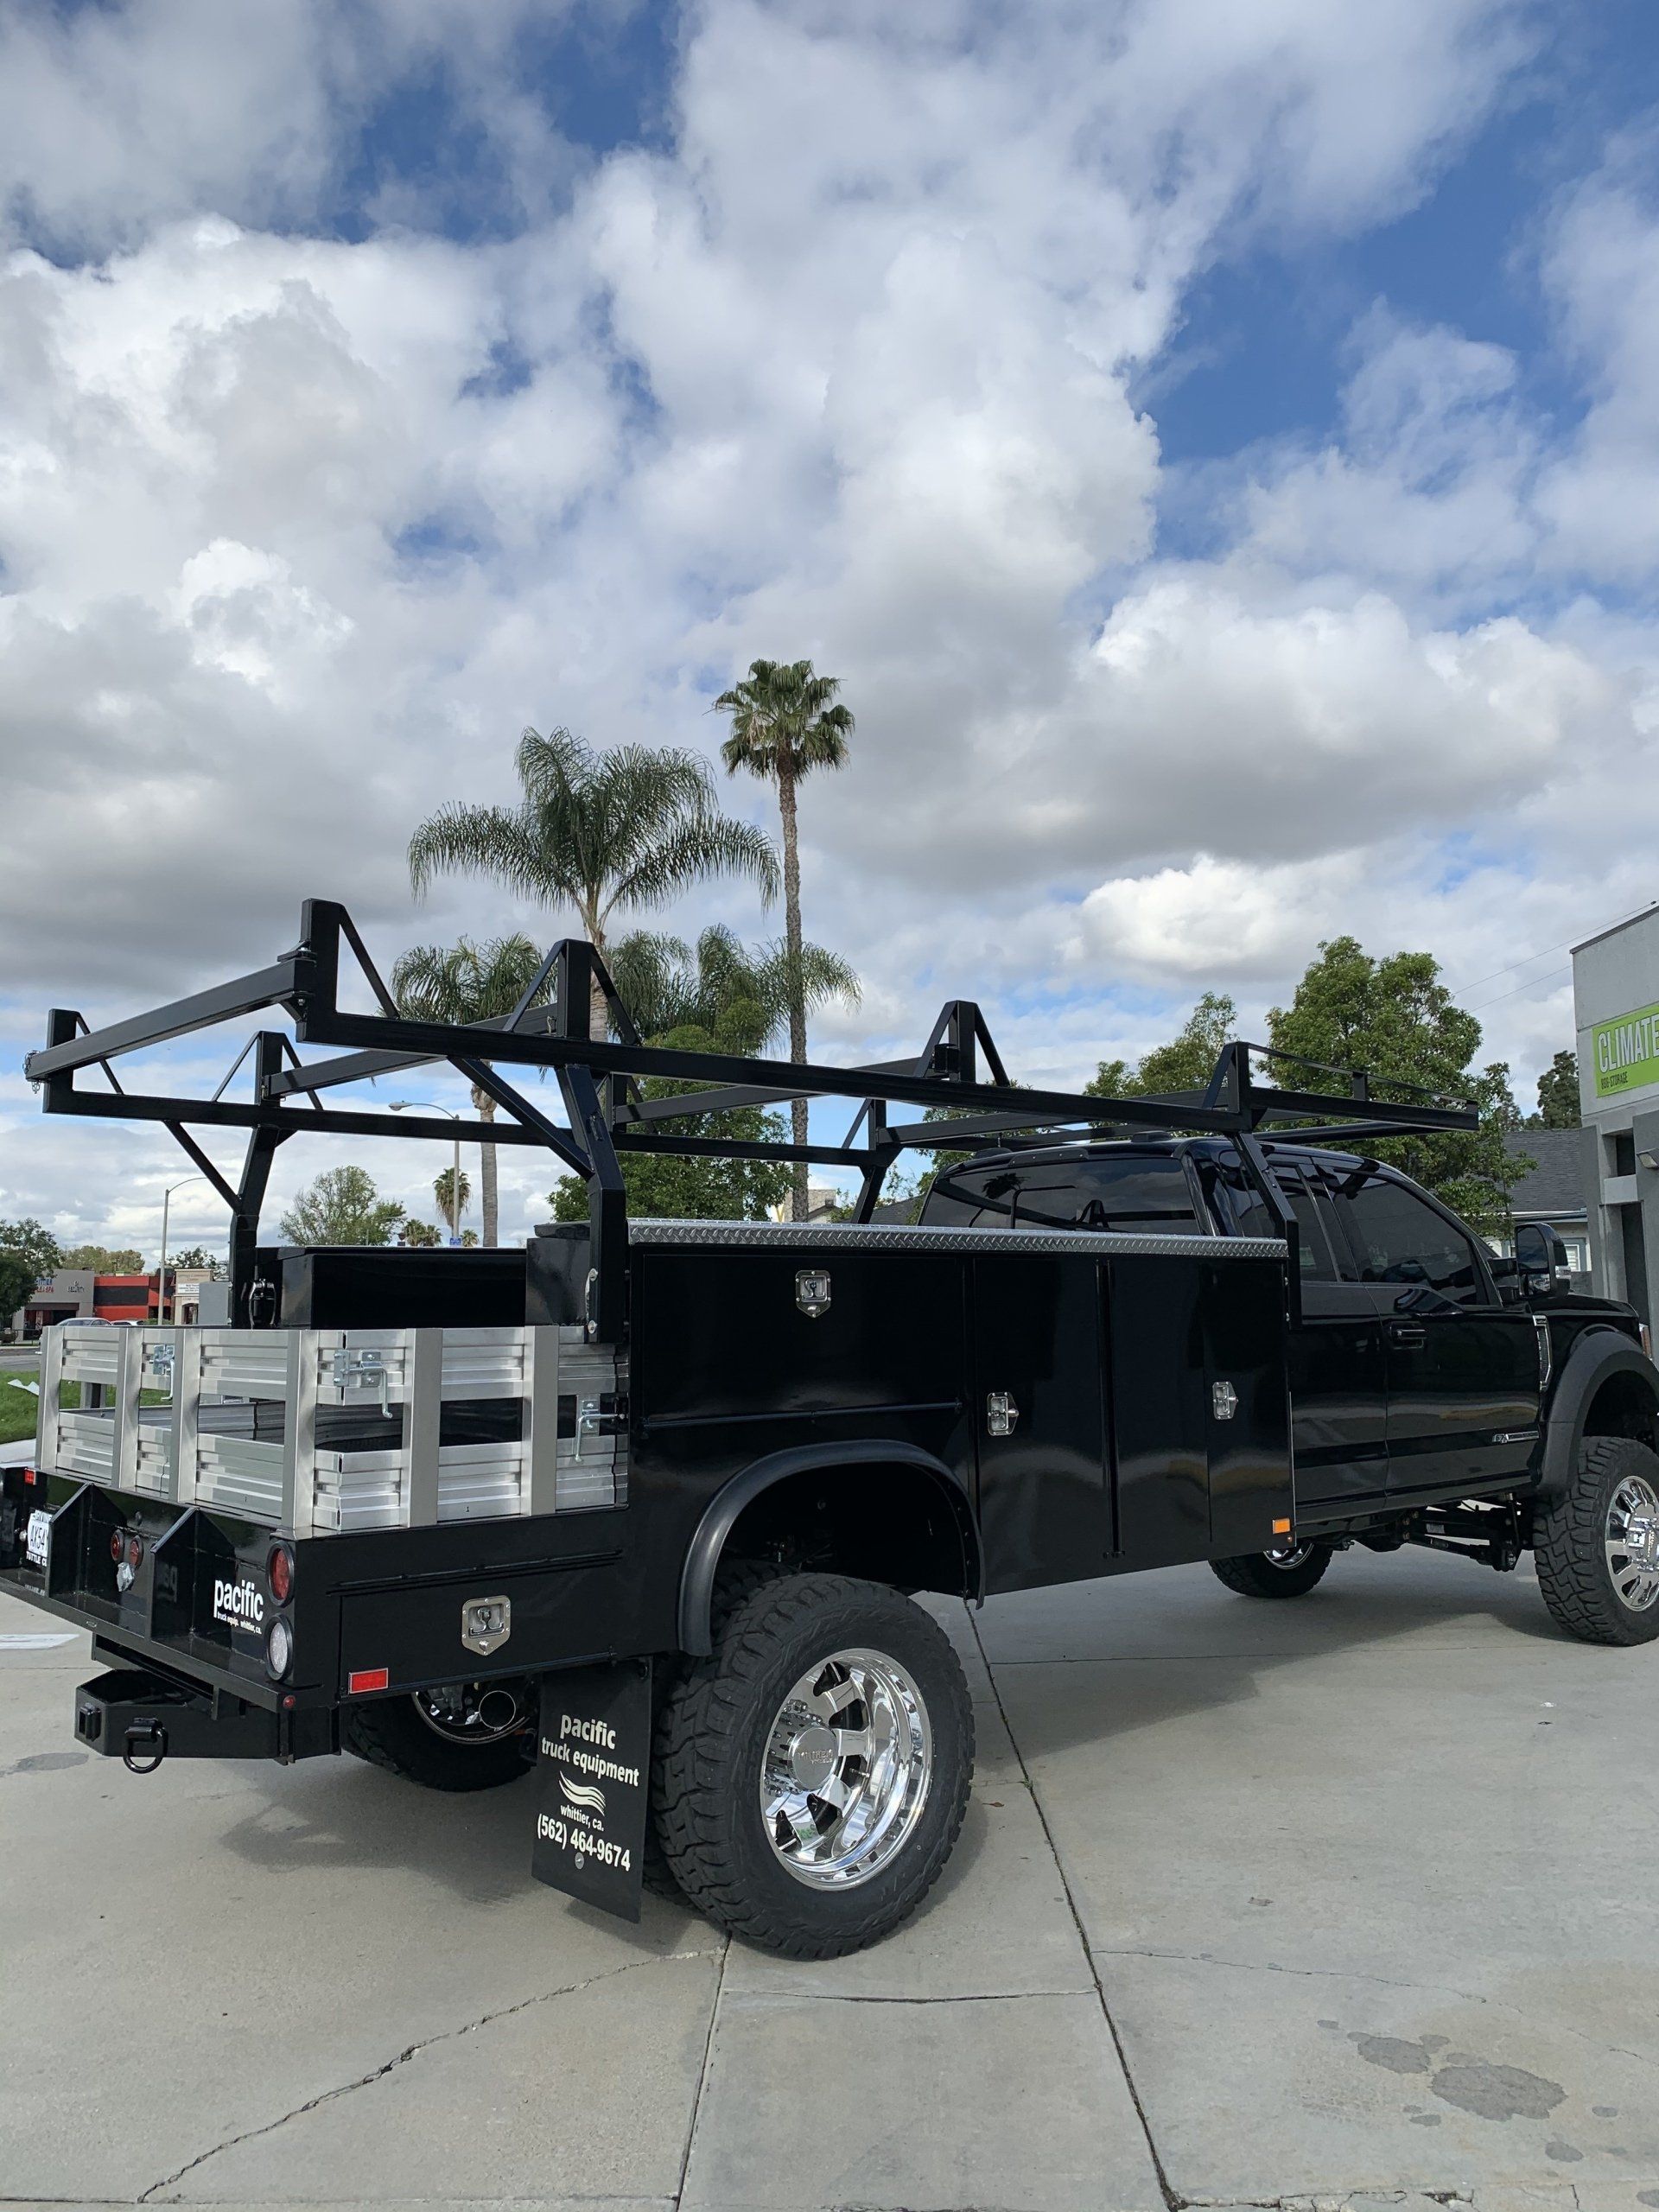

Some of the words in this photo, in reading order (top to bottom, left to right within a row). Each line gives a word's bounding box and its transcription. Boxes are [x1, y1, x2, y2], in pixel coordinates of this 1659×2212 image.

[1599, 1014, 1659, 1073] CLIMATE
[213, 1580, 264, 1622] pacific
[560, 1714, 616, 1750] pacific
[541, 1737, 570, 1763] truck
[572, 1751, 639, 1787] equipment
[560, 1804, 591, 1829] whittier,
[592, 1818, 605, 1832] ca.
[537, 1813, 568, 1850] (562)
[569, 1827, 631, 1872] 464-9674
